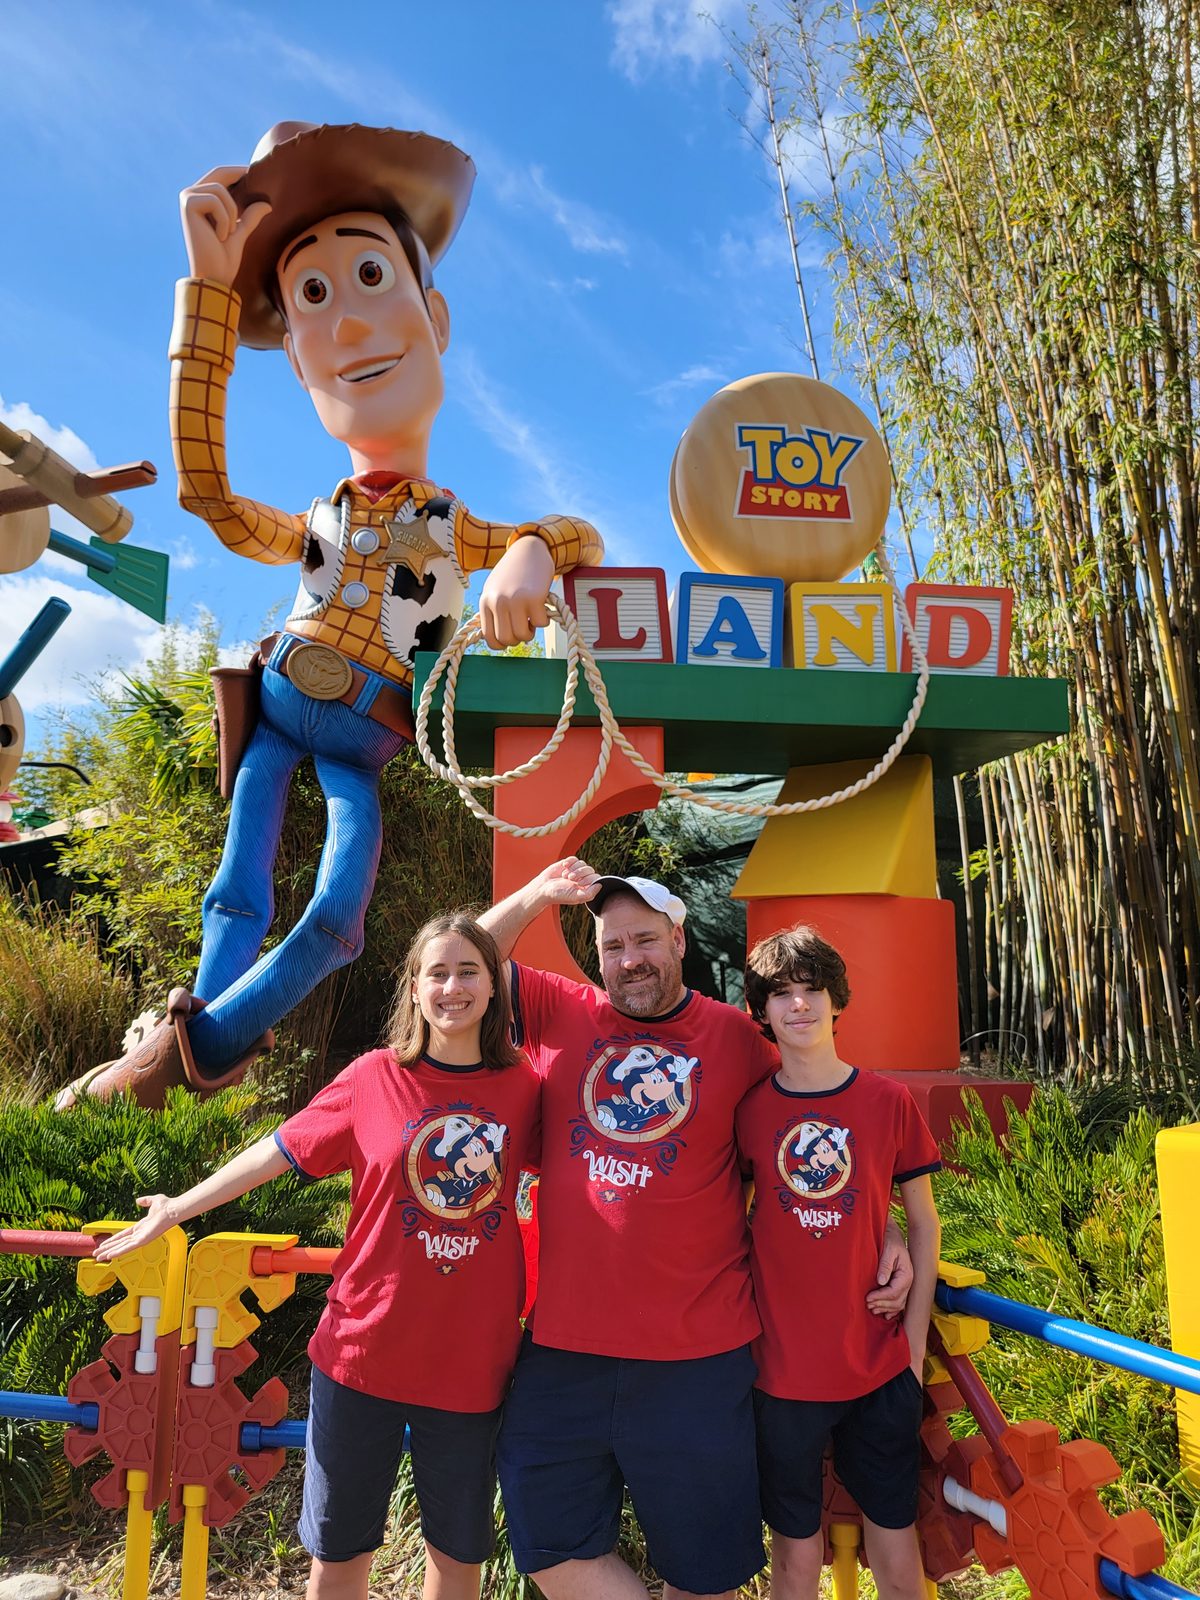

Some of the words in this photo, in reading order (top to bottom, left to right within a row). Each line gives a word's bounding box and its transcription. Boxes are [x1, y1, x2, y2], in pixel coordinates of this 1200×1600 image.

[739, 427, 861, 488] TOY
[751, 486, 841, 512] STORY
[396, 529, 430, 555] SHERIFF
[588, 588, 992, 668] LAND
[583, 1150, 653, 1187] WISH
[793, 1207, 842, 1228] WISH
[417, 1231, 480, 1260] WISH
